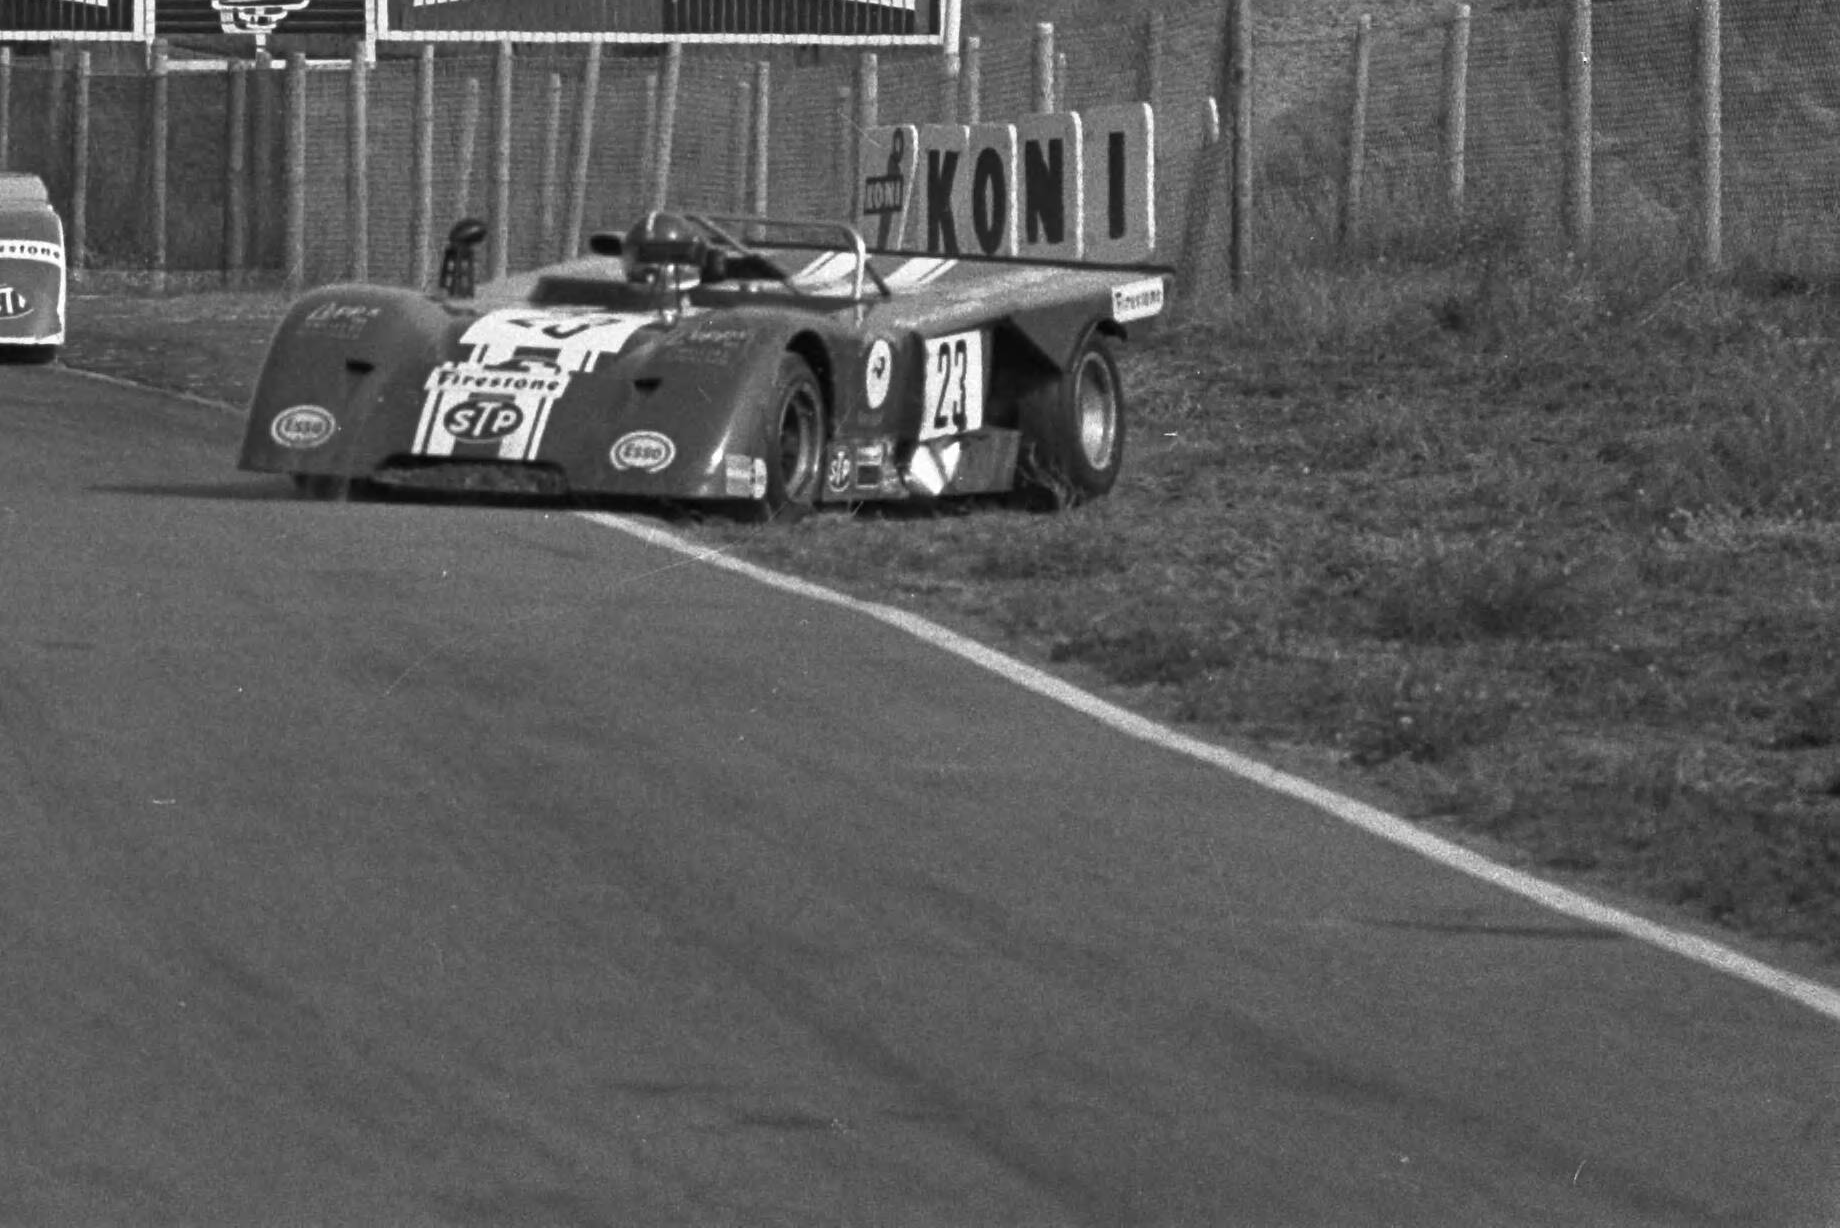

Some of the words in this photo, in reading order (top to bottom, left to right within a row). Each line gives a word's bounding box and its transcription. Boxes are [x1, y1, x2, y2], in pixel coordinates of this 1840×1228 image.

[926, 132, 1127, 255] KONI
[438, 371, 561, 392] Firestone
[933, 338, 968, 432] 23
[449, 401, 518, 437] STP
